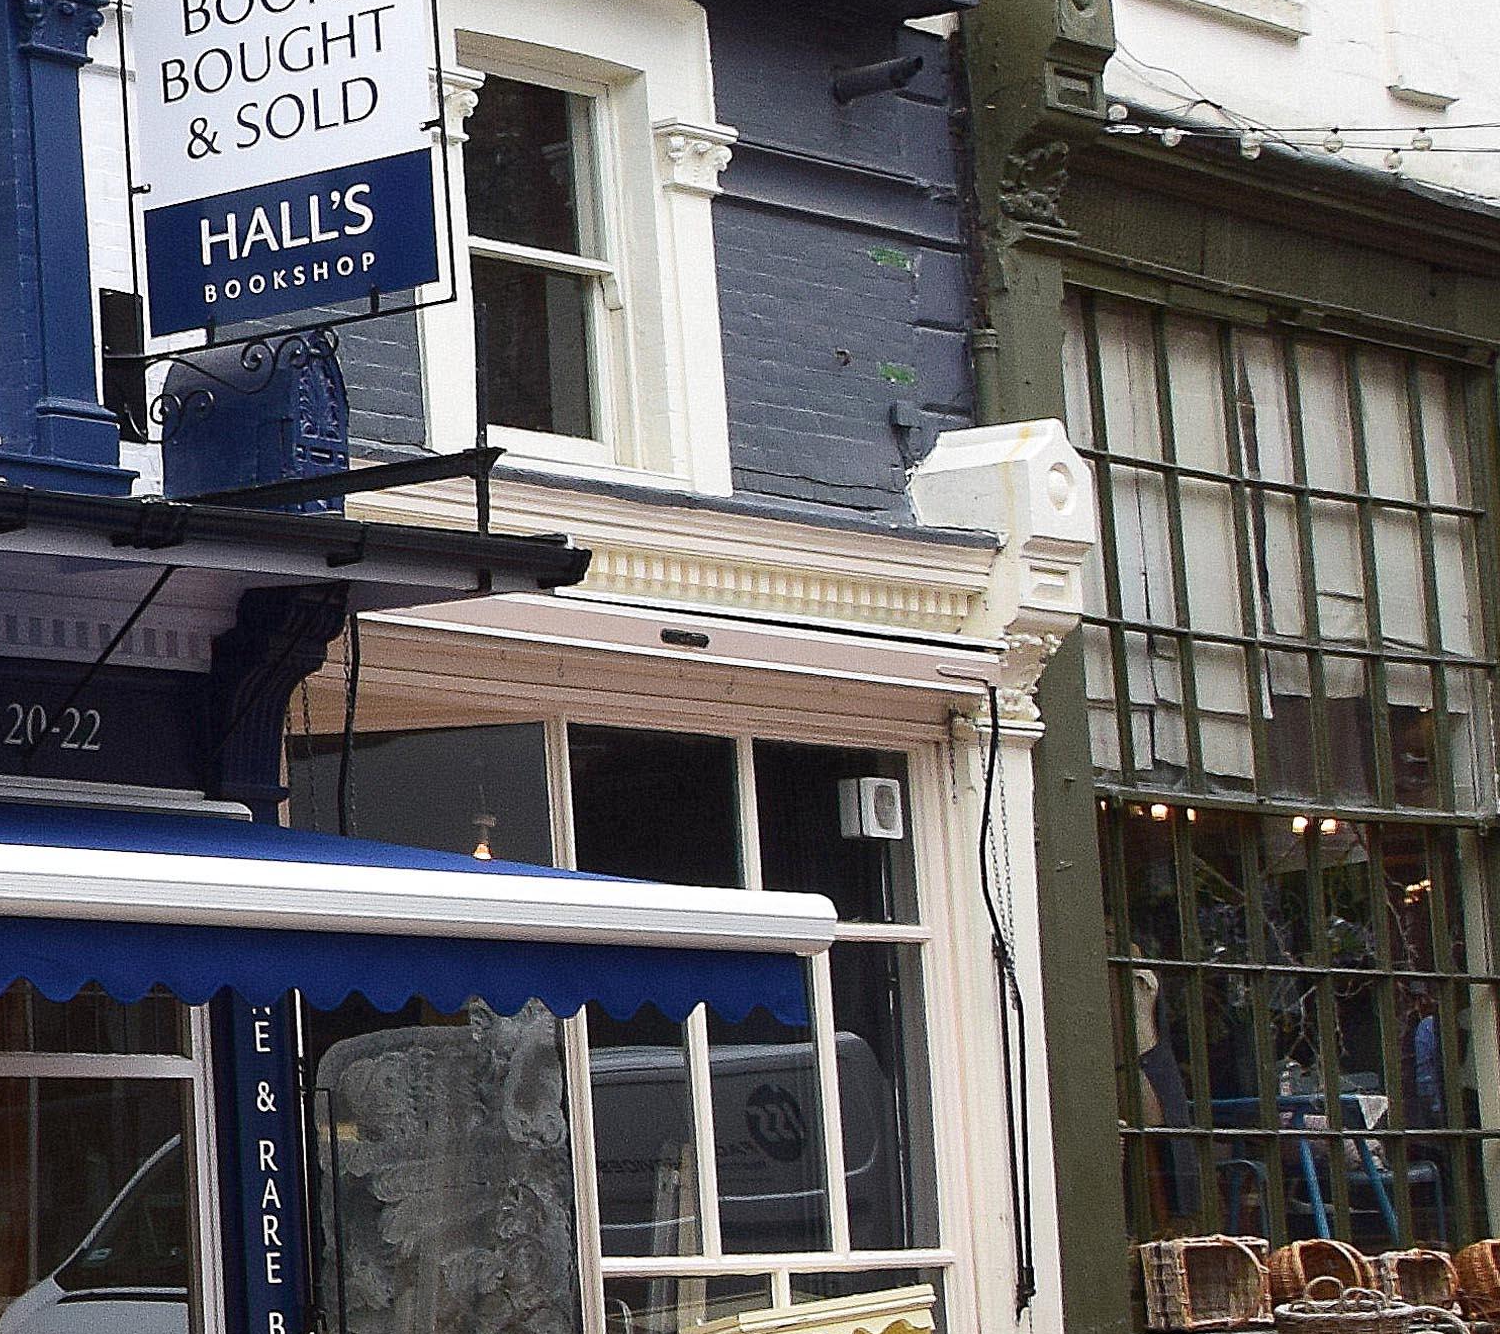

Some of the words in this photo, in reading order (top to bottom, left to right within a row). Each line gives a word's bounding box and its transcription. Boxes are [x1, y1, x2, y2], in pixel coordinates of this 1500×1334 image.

[161, 3, 395, 105] BOUGHT
[186, 119, 221, 159] &
[236, 75, 379, 148] SOLD
[199, 183, 374, 267] HALL’S
[204, 251, 376, 303] BOOKSHOP
[2, 699, 102, 753] 20-22
[256, 1083, 277, 1112] &
[258, 1141, 282, 1286] RARE
